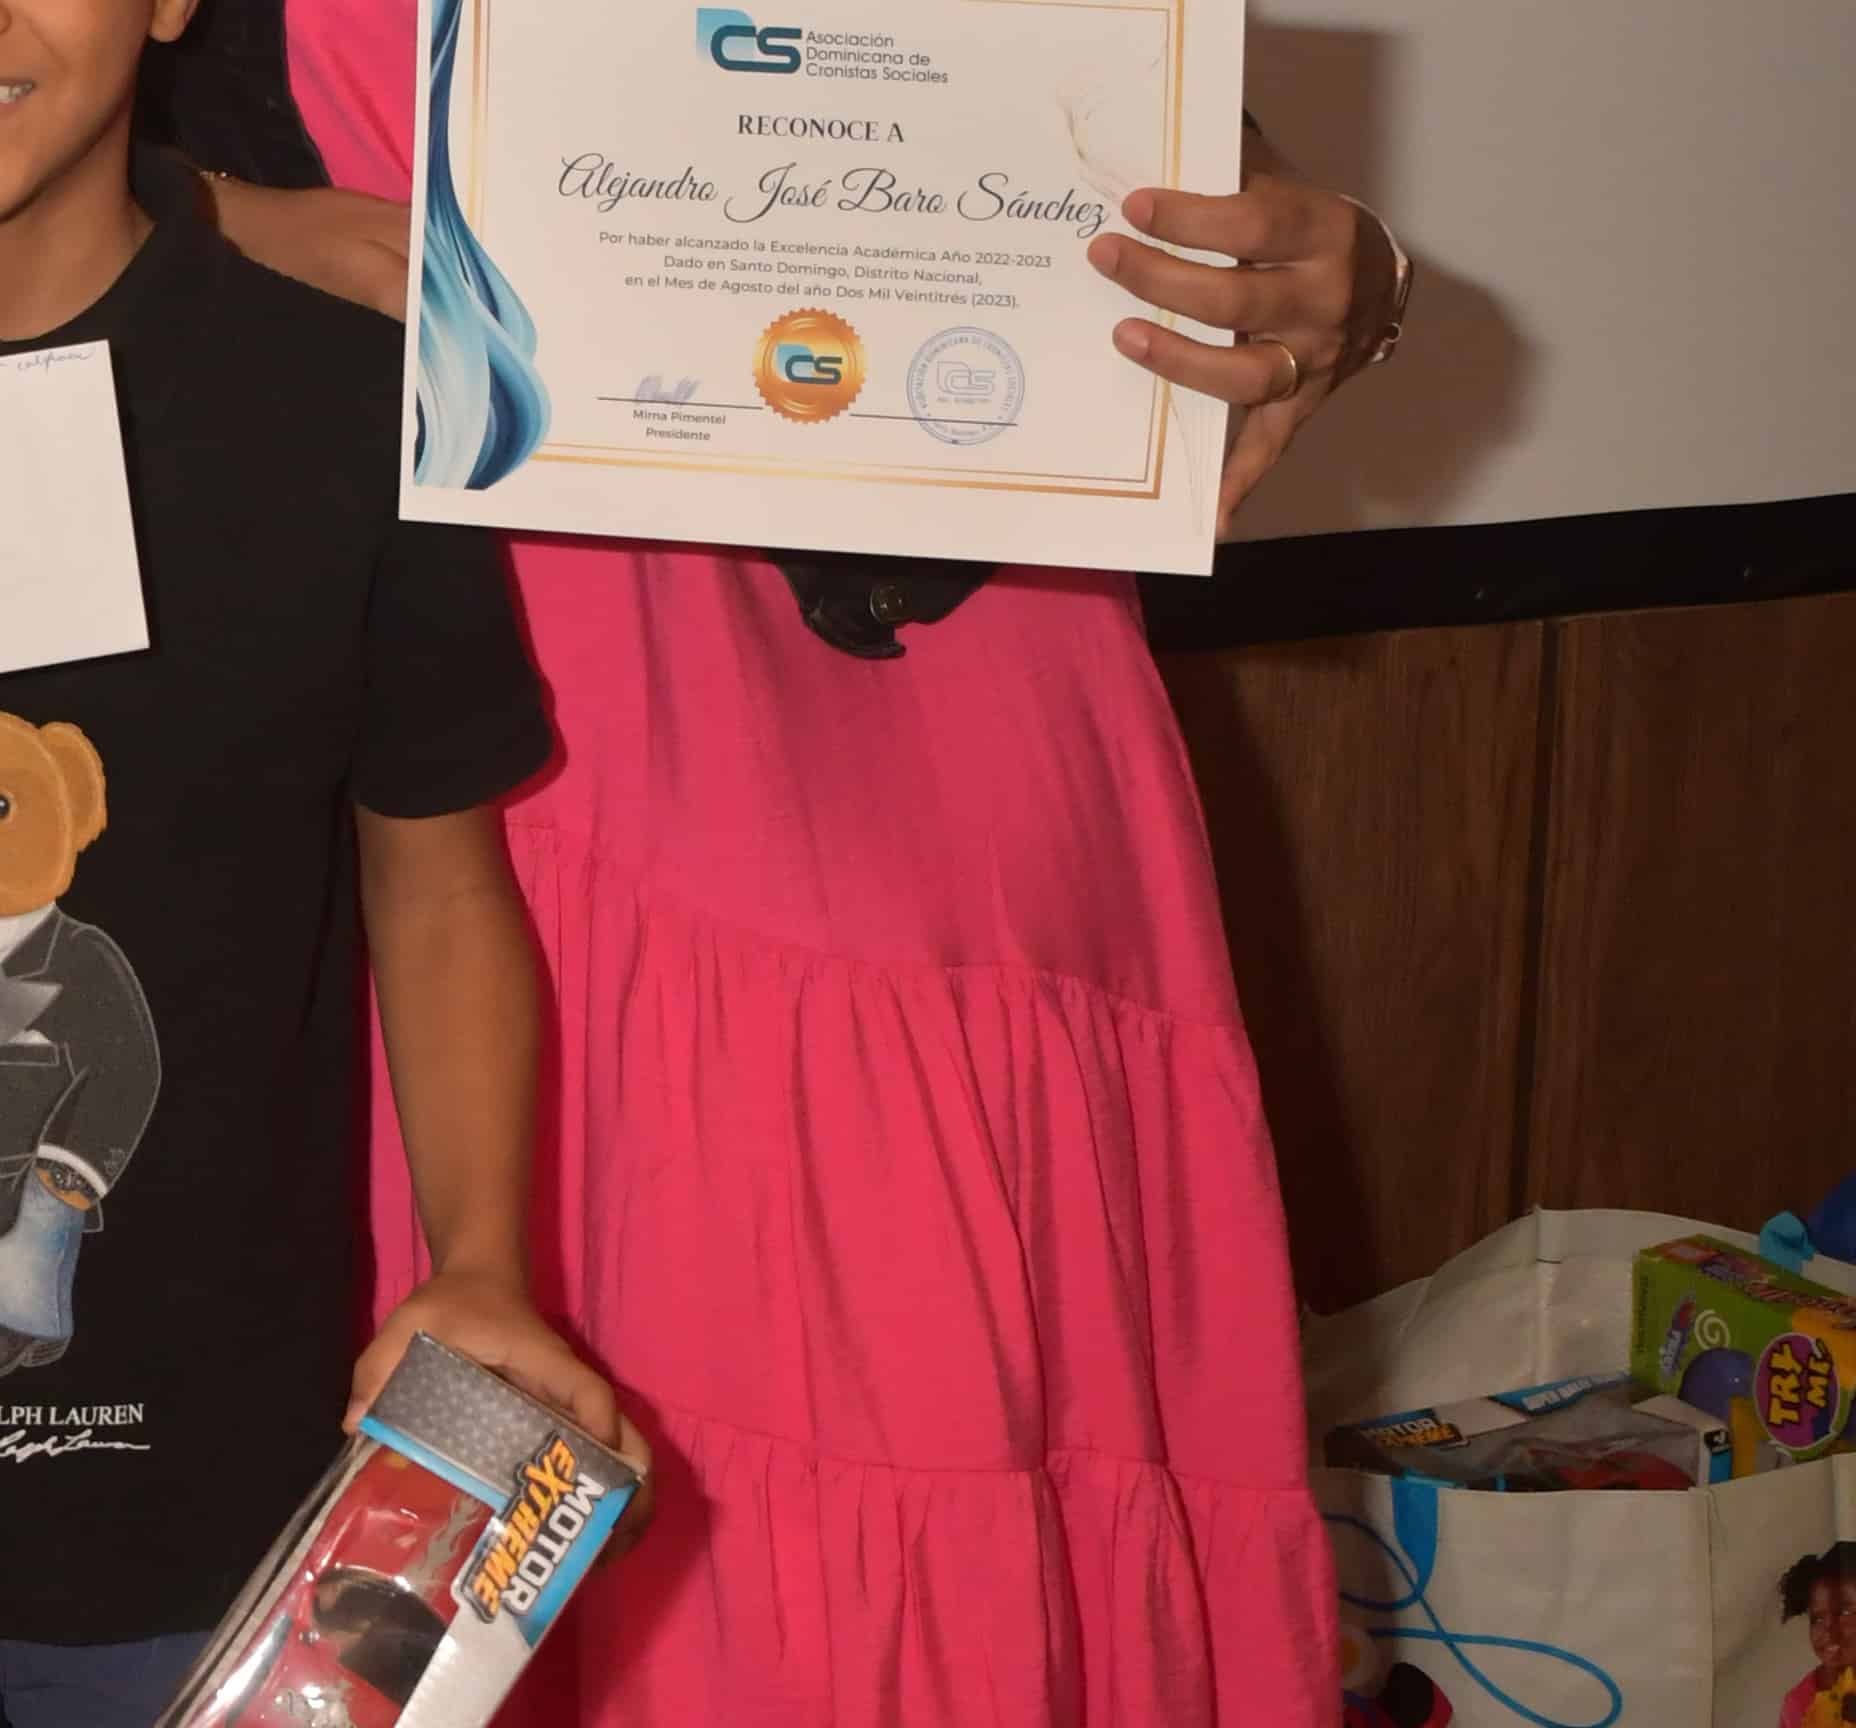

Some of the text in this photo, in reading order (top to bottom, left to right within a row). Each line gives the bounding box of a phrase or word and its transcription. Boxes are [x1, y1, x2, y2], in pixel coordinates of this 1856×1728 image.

[806, 30, 894, 47] Asociación
[806, 47, 930, 66] Dominicana de
[806, 63, 948, 83] Cronistas Sociales
[738, 114, 904, 143] RECONOCE A
[558, 152, 1109, 239] Alejandro José Baro Sánchez
[599, 231, 1052, 268] Por haber alcanzado la Excelencia Académica Año 2022-2023
[664, 255, 982, 286] Dado en Santo Domingo, Distrito Nacional,
[625, 275, 1019, 309] en el Mes de Agosto del año Dos Mil Veintitrés (2023).
[670, 411, 726, 425] Pimentel
[645, 427, 711, 441] Presidente
[1770, 1344, 1802, 1424] TRY
[48, 1402, 144, 1425] LAUREN
[473, 1439, 576, 1616] EXTREME
[501, 1472, 606, 1612] MOTOR
